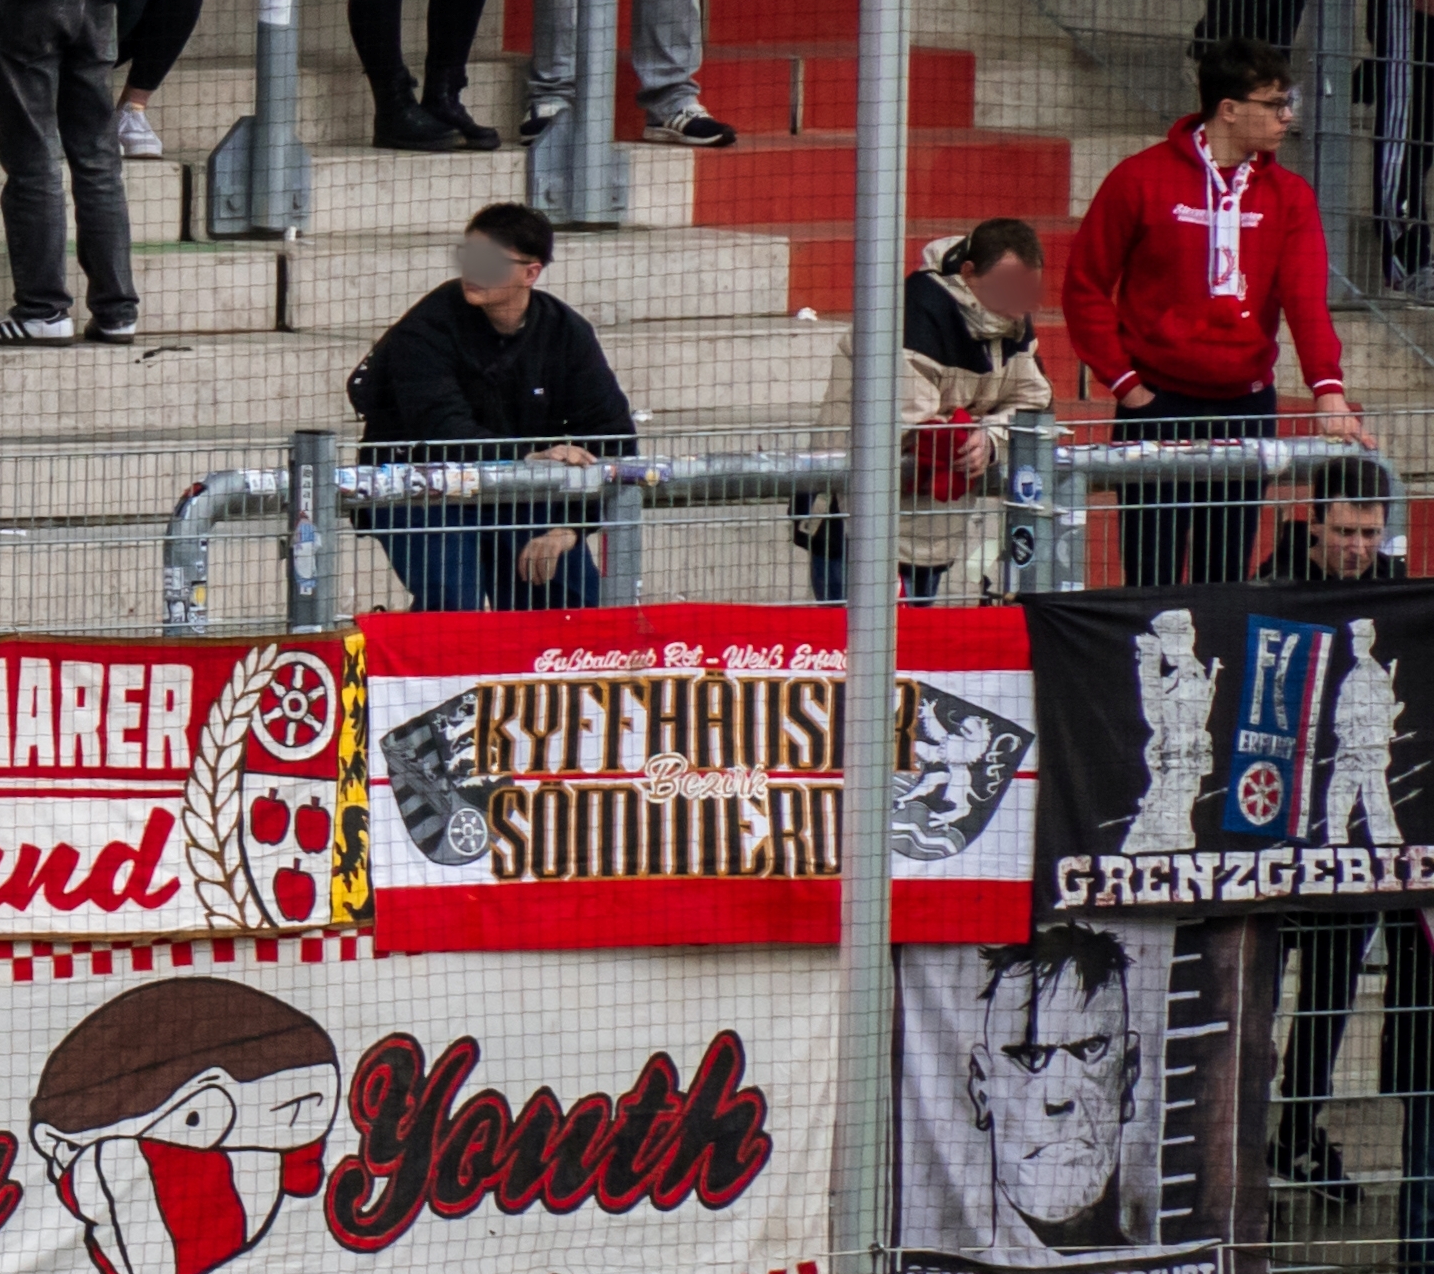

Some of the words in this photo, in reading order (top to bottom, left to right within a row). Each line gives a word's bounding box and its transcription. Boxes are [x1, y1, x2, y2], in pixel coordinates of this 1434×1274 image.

[534, 647, 658, 673] Fußballclub
[662, 641, 703, 669] Rot
[722, 643, 785, 671] Weiß
[473, 670, 922, 773] KYFFHÄUSR
[1237, 729, 1298, 761] ERFURT
[644, 751, 770, 803] Bezirk
[323, 1028, 772, 1253] Youth
